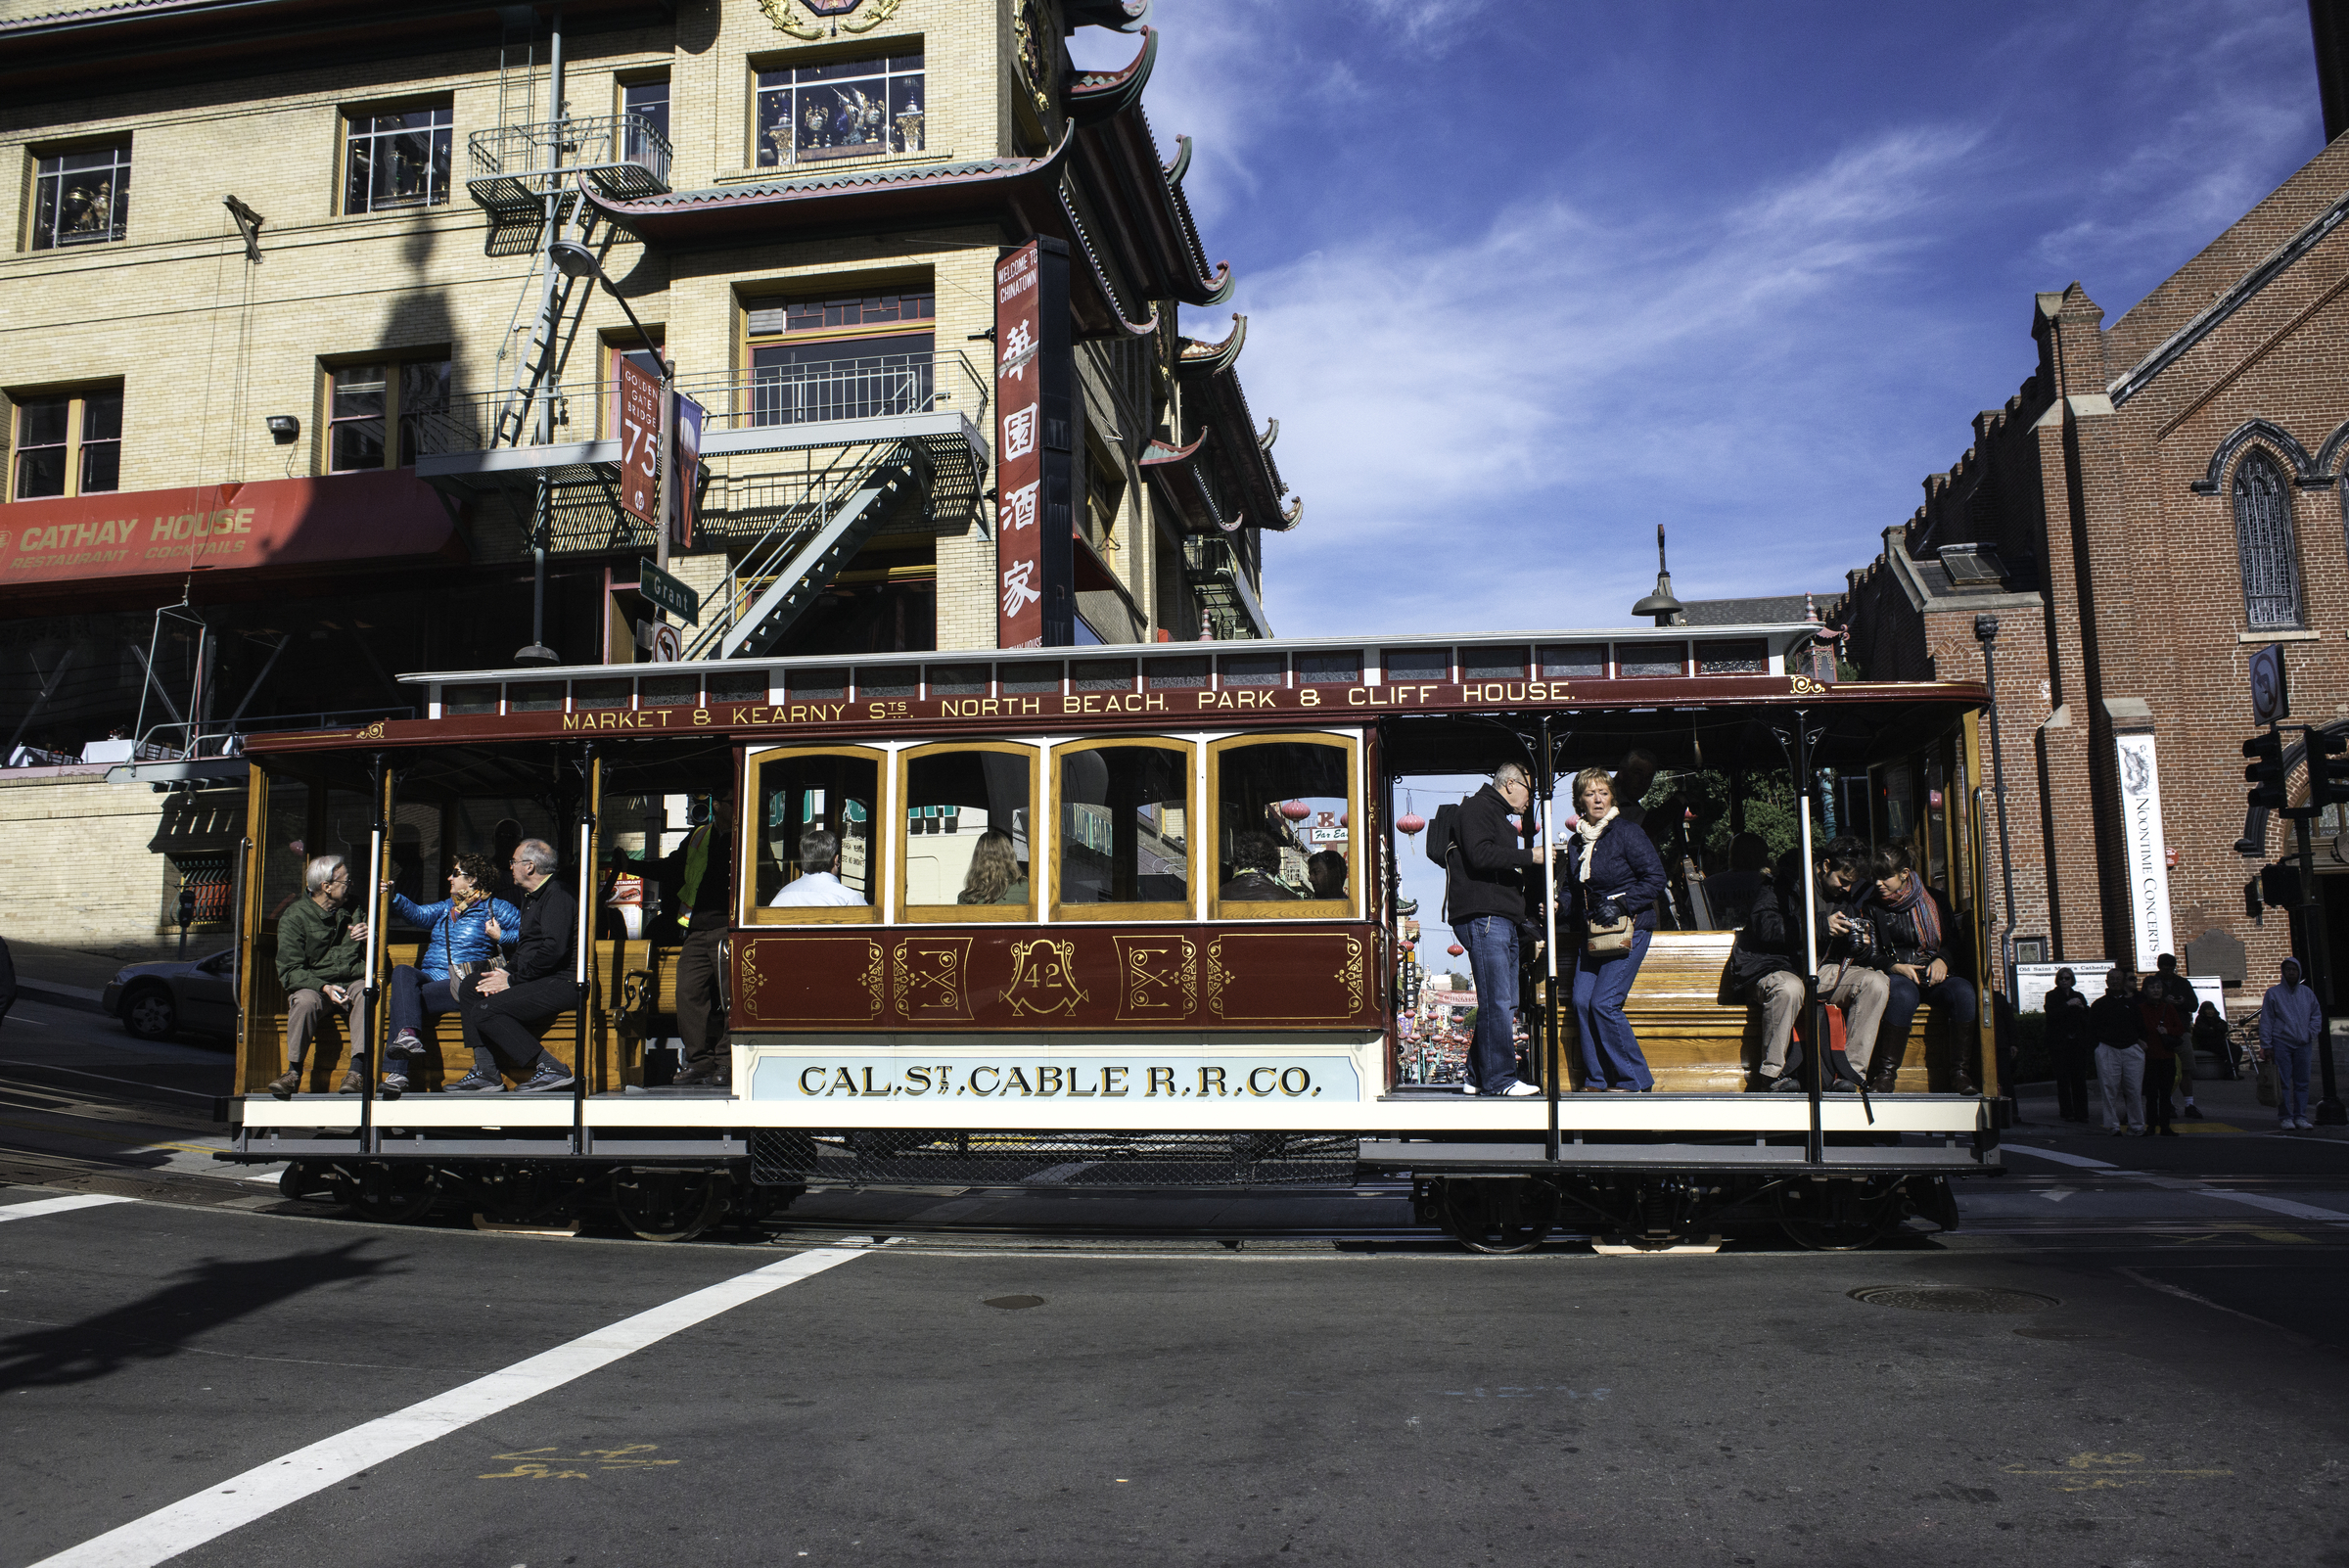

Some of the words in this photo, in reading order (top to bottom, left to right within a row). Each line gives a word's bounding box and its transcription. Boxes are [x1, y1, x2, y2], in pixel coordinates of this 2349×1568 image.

[998, 254, 1028, 285] WELCOME
[1029, 248, 1037, 266] TO
[1000, 269, 1036, 303] CHINATOWN
[625, 370, 658, 400] GOLDEN
[631, 390, 652, 410] GATE
[627, 401, 657, 428] BRIDGE
[624, 418, 657, 478] 75
[19, 519, 139, 552] CATHAY
[150, 508, 255, 541] HOUSE
[9, 549, 129, 570] RESTAURANT
[144, 539, 246, 559] COCKTAILS
[654, 576, 687, 612] Grant
[563, 710, 671, 731] MARKET
[693, 709, 712, 726] &
[733, 704, 846, 724] KEARNY
[942, 696, 1039, 717] NORTH
[1199, 690, 1276, 710] PARK
[1300, 688, 1321, 707] &
[1349, 685, 1438, 706] CLIFF
[1464, 682, 1576, 702] HOUSE.
[1314, 830, 1330, 839] Far
[2136, 798, 2152, 875] NOONTIME
[2142, 877, 2160, 952] CONCERTS
[1023, 963, 1063, 988] 42
[1443, 993, 1477, 1002] CHINATO
